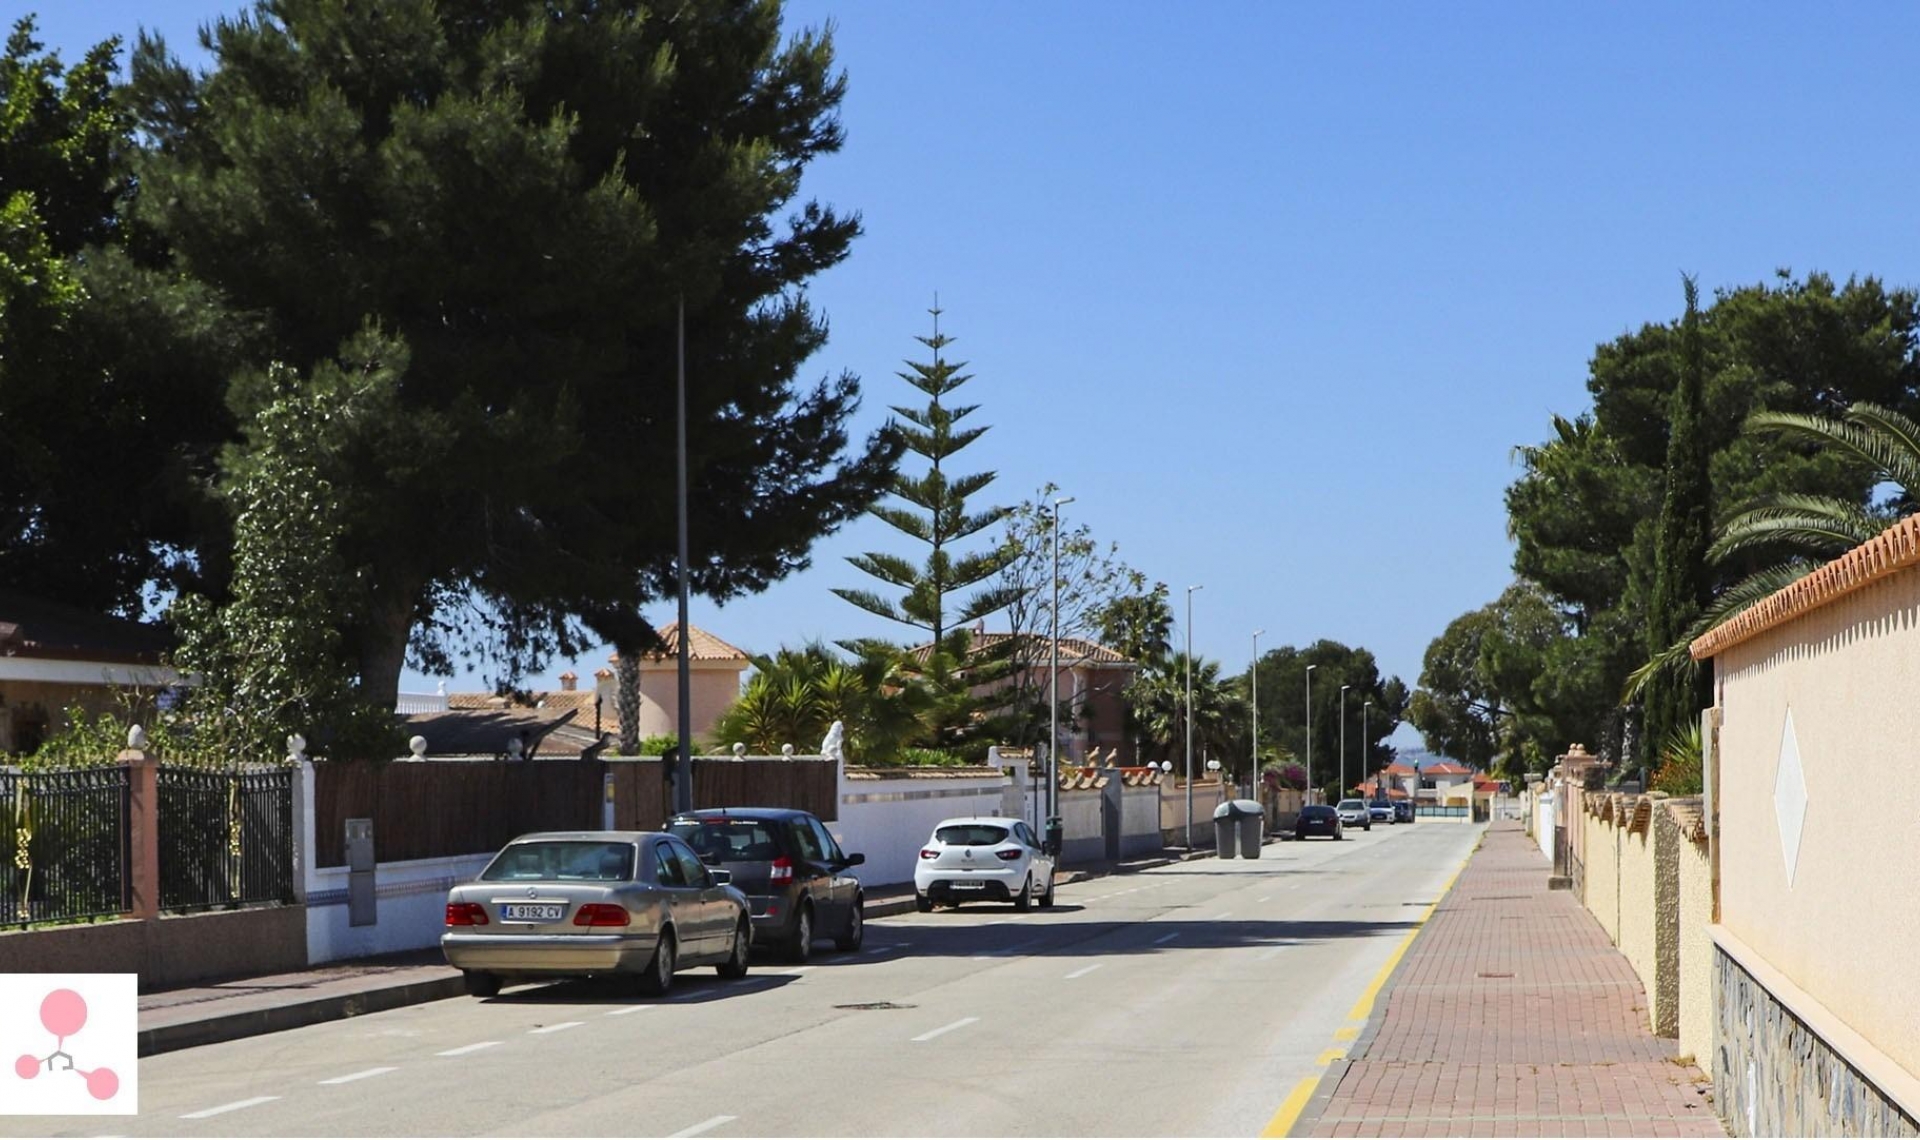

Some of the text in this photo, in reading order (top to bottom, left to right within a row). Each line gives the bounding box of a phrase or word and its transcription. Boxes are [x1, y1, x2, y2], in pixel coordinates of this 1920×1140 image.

[508, 906, 560, 918] A 9192 CV
